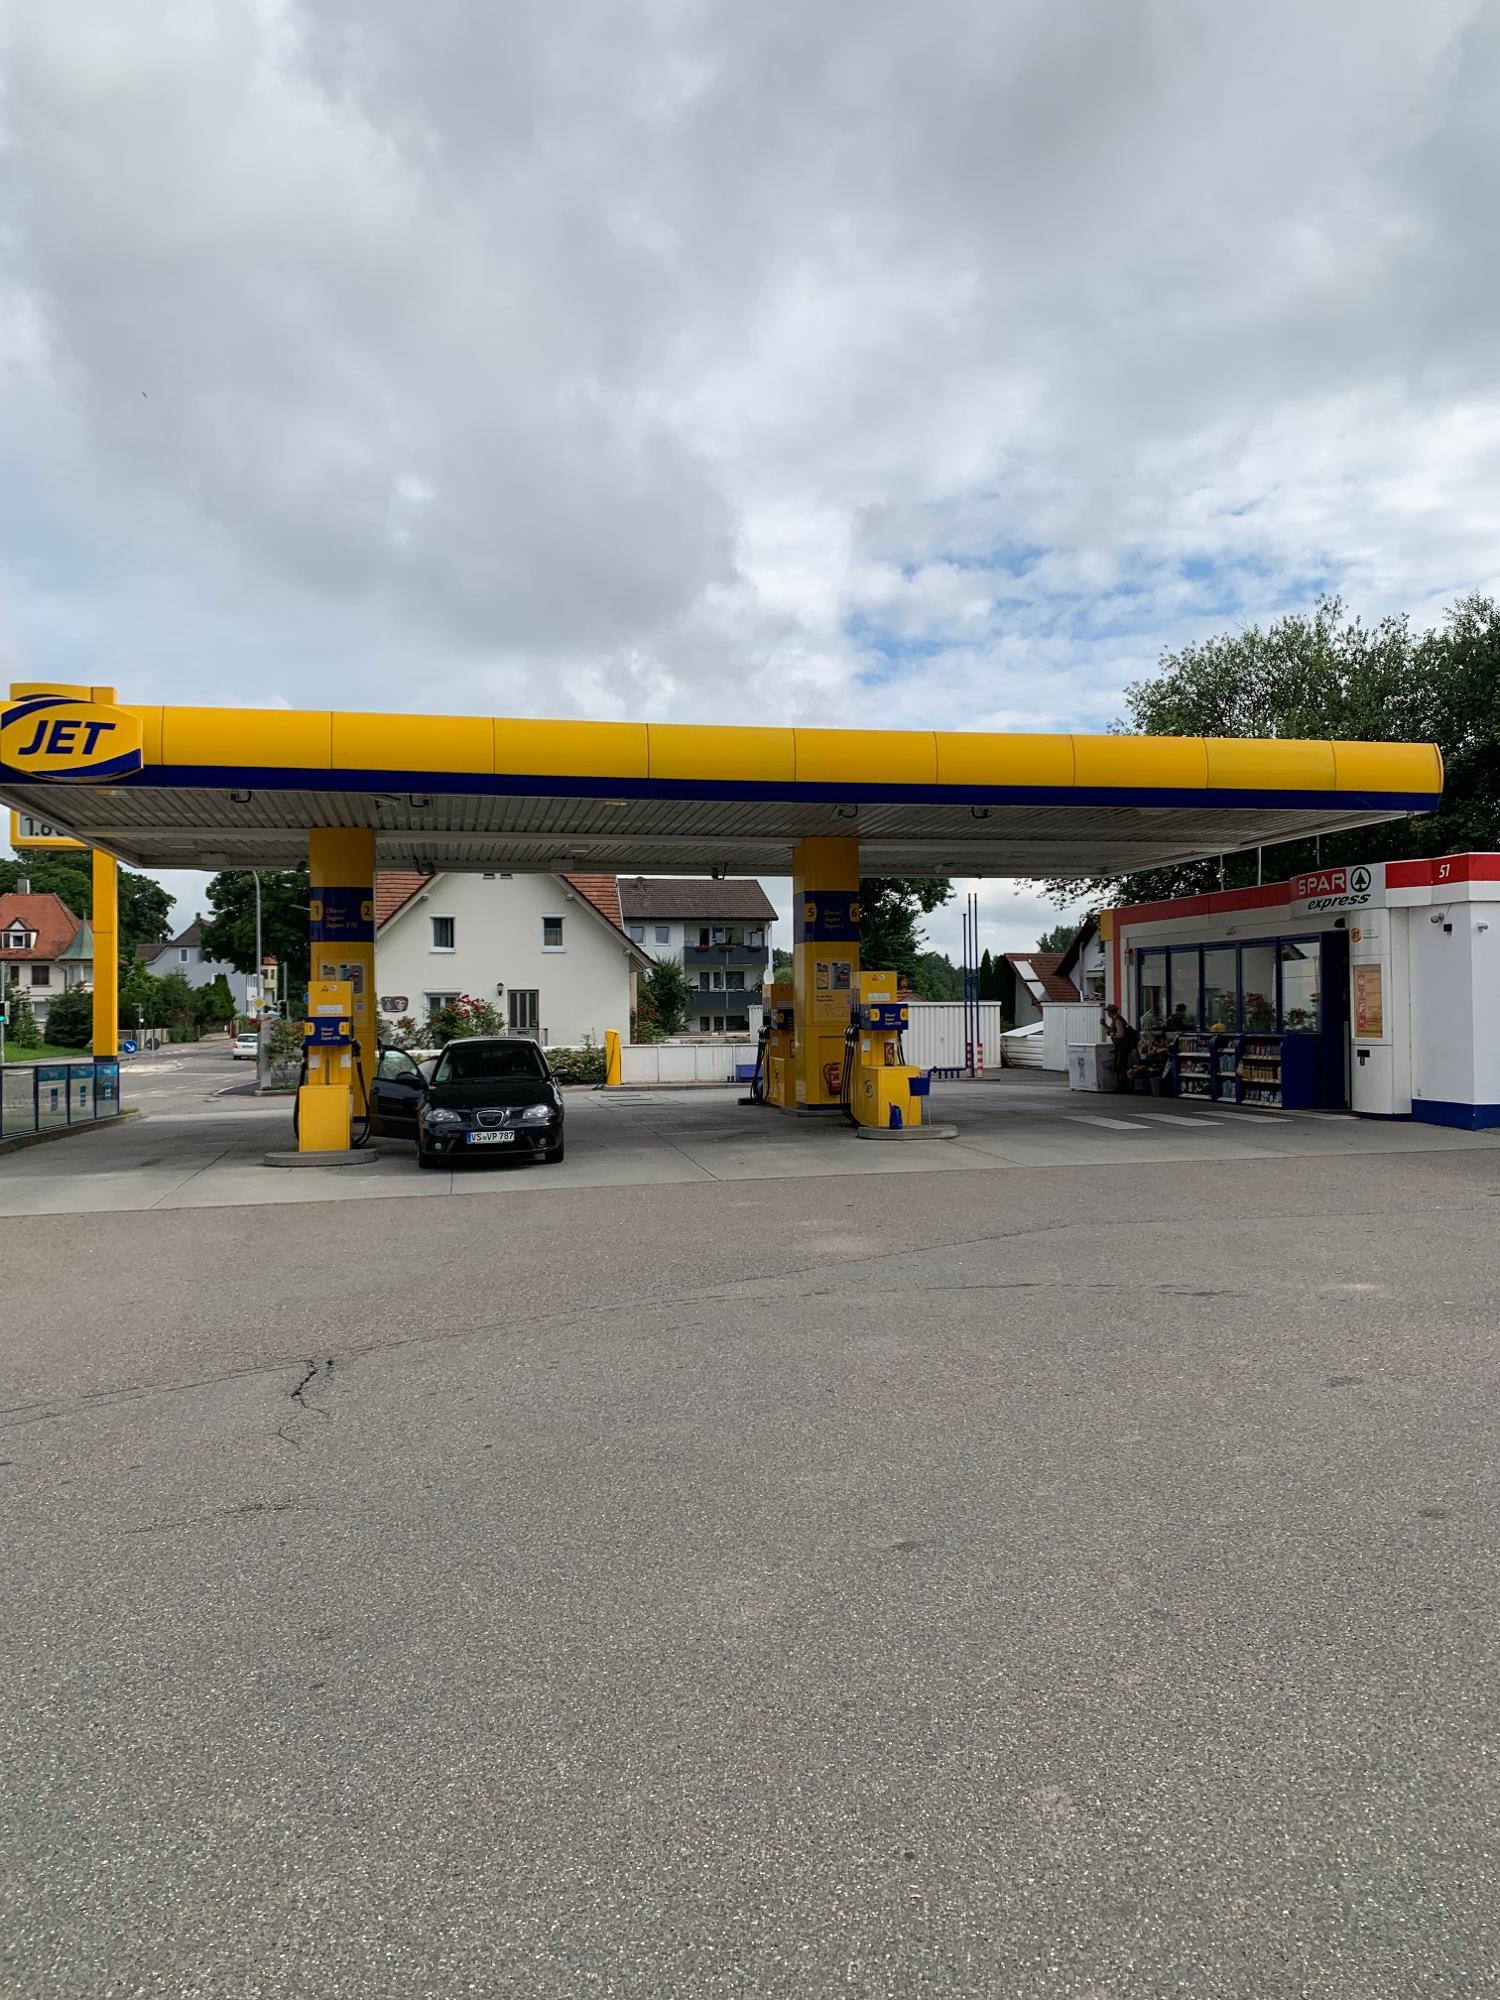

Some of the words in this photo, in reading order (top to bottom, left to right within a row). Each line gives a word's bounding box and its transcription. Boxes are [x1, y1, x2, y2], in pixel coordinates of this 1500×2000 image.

[18, 719, 117, 755] JET
[25, 816, 65, 836] 1.6
[1298, 872, 1345, 896] SPAR
[364, 905, 371, 917] 2
[1307, 893, 1371, 911] express
[807, 907, 815, 918] 5
[471, 1133, 481, 1141] VS
[487, 1132, 497, 1141] VP
[499, 1132, 514, 1140] 787
